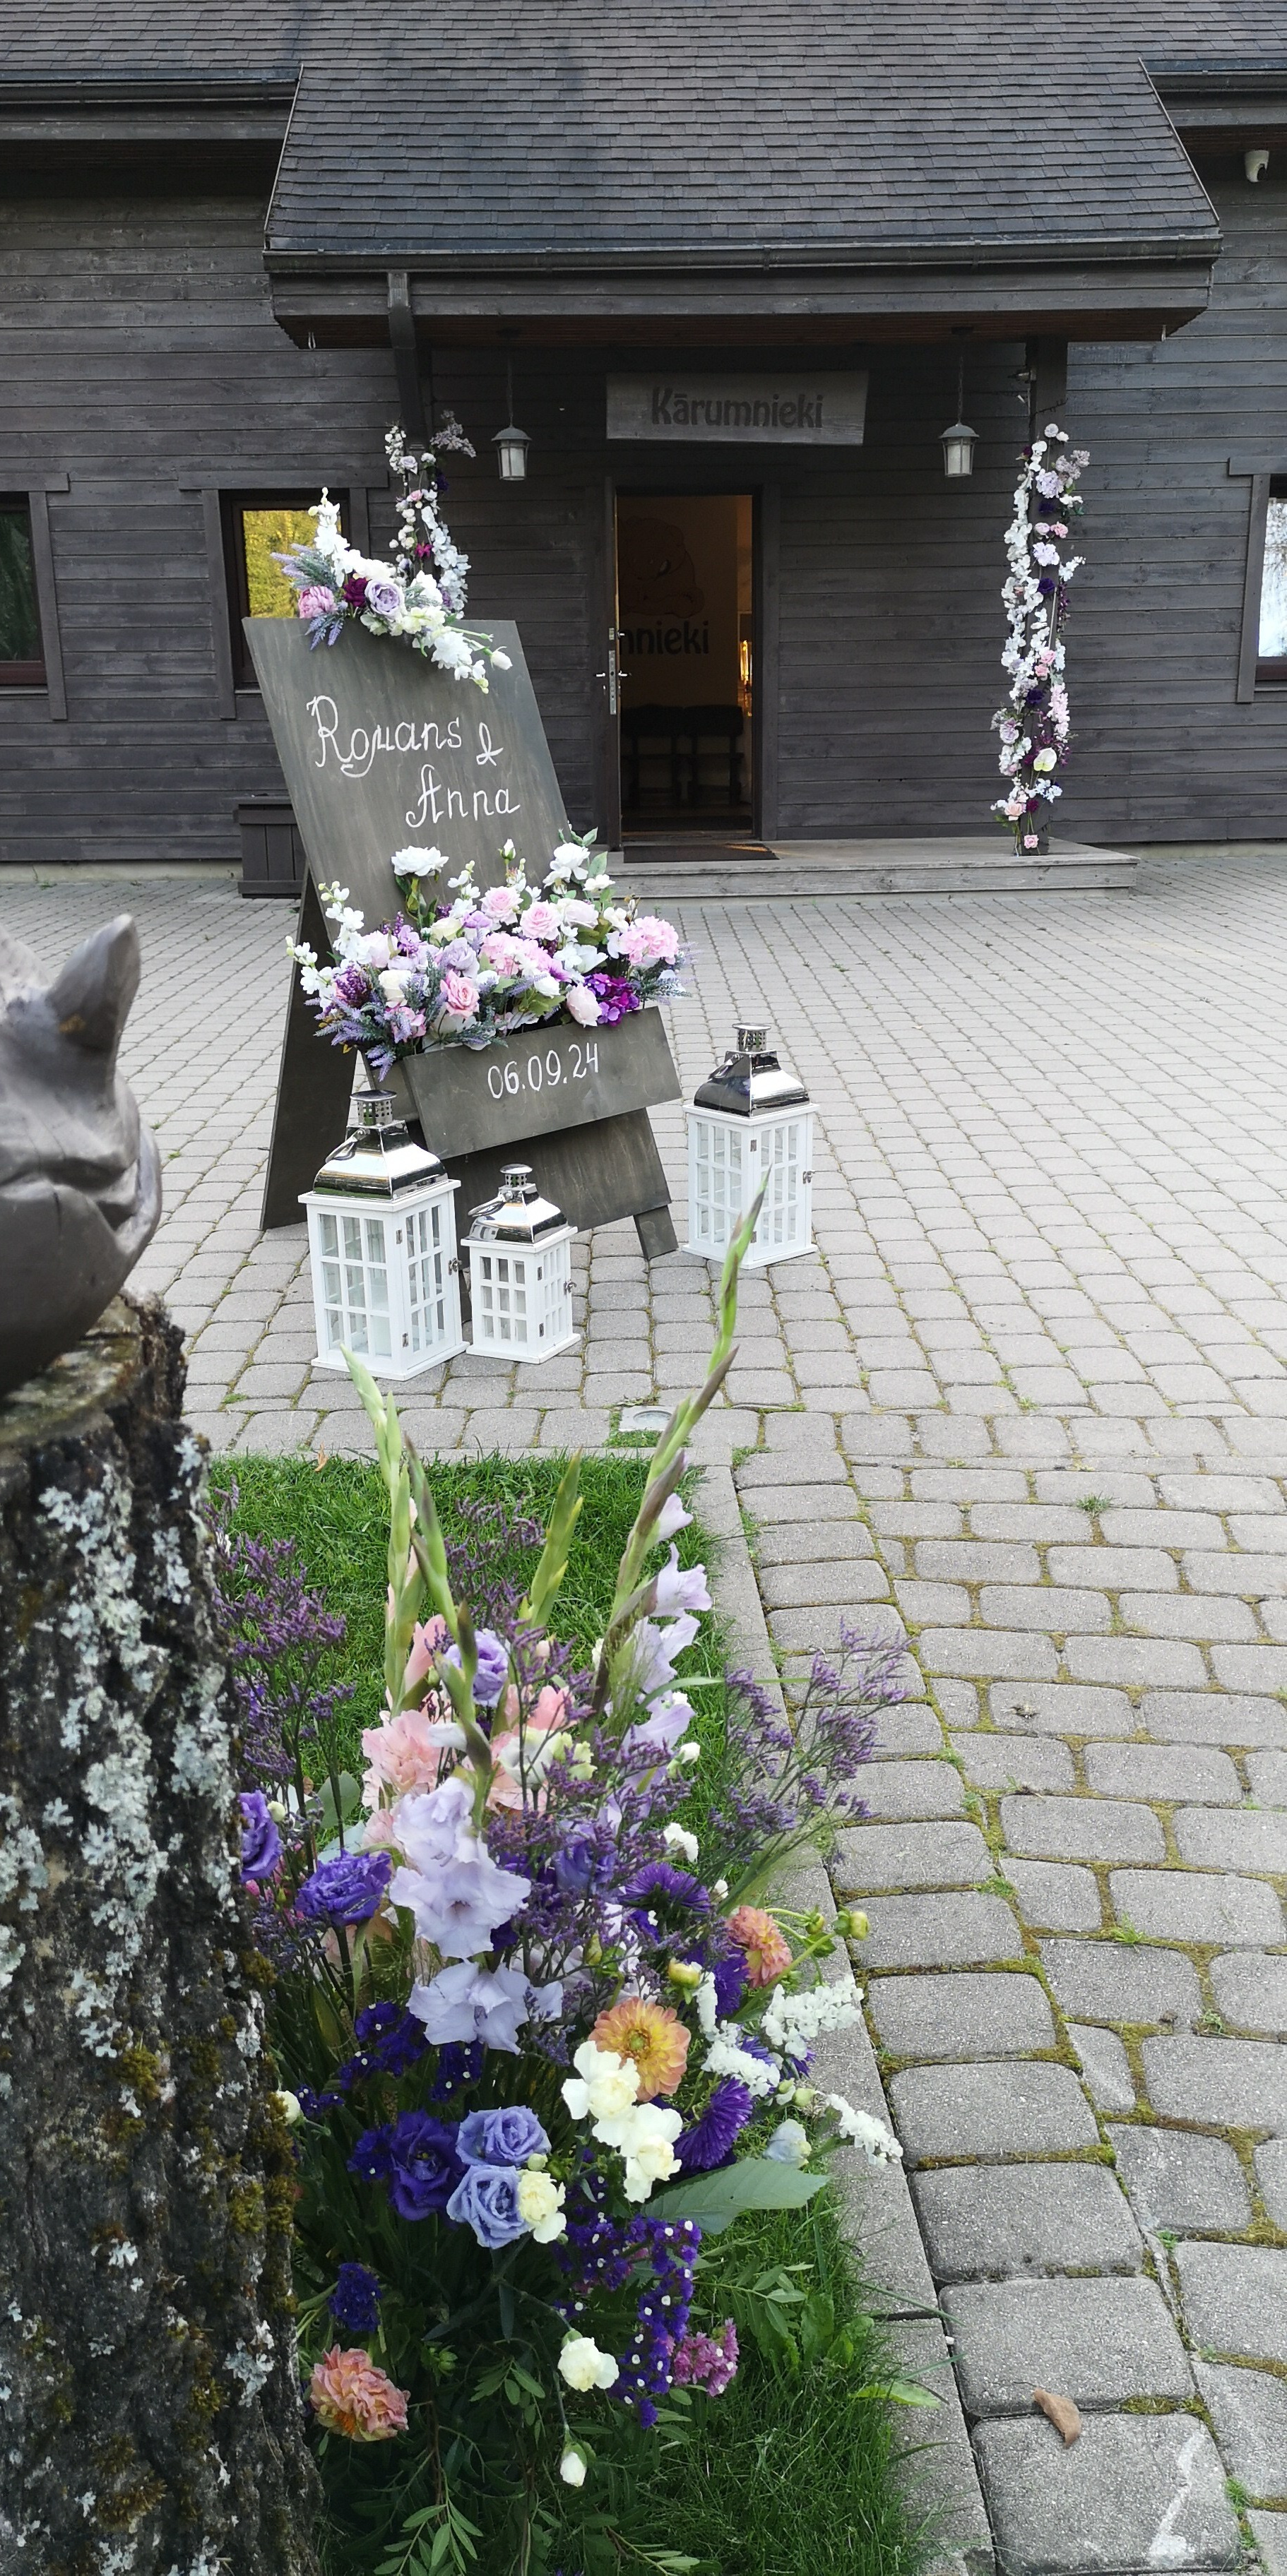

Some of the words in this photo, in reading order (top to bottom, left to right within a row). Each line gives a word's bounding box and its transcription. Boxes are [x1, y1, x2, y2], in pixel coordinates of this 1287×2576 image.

[651, 387, 824, 429] Kārumnieki
[405, 764, 521, 828] Anna
[487, 1042, 599, 1099] 06.09.24
